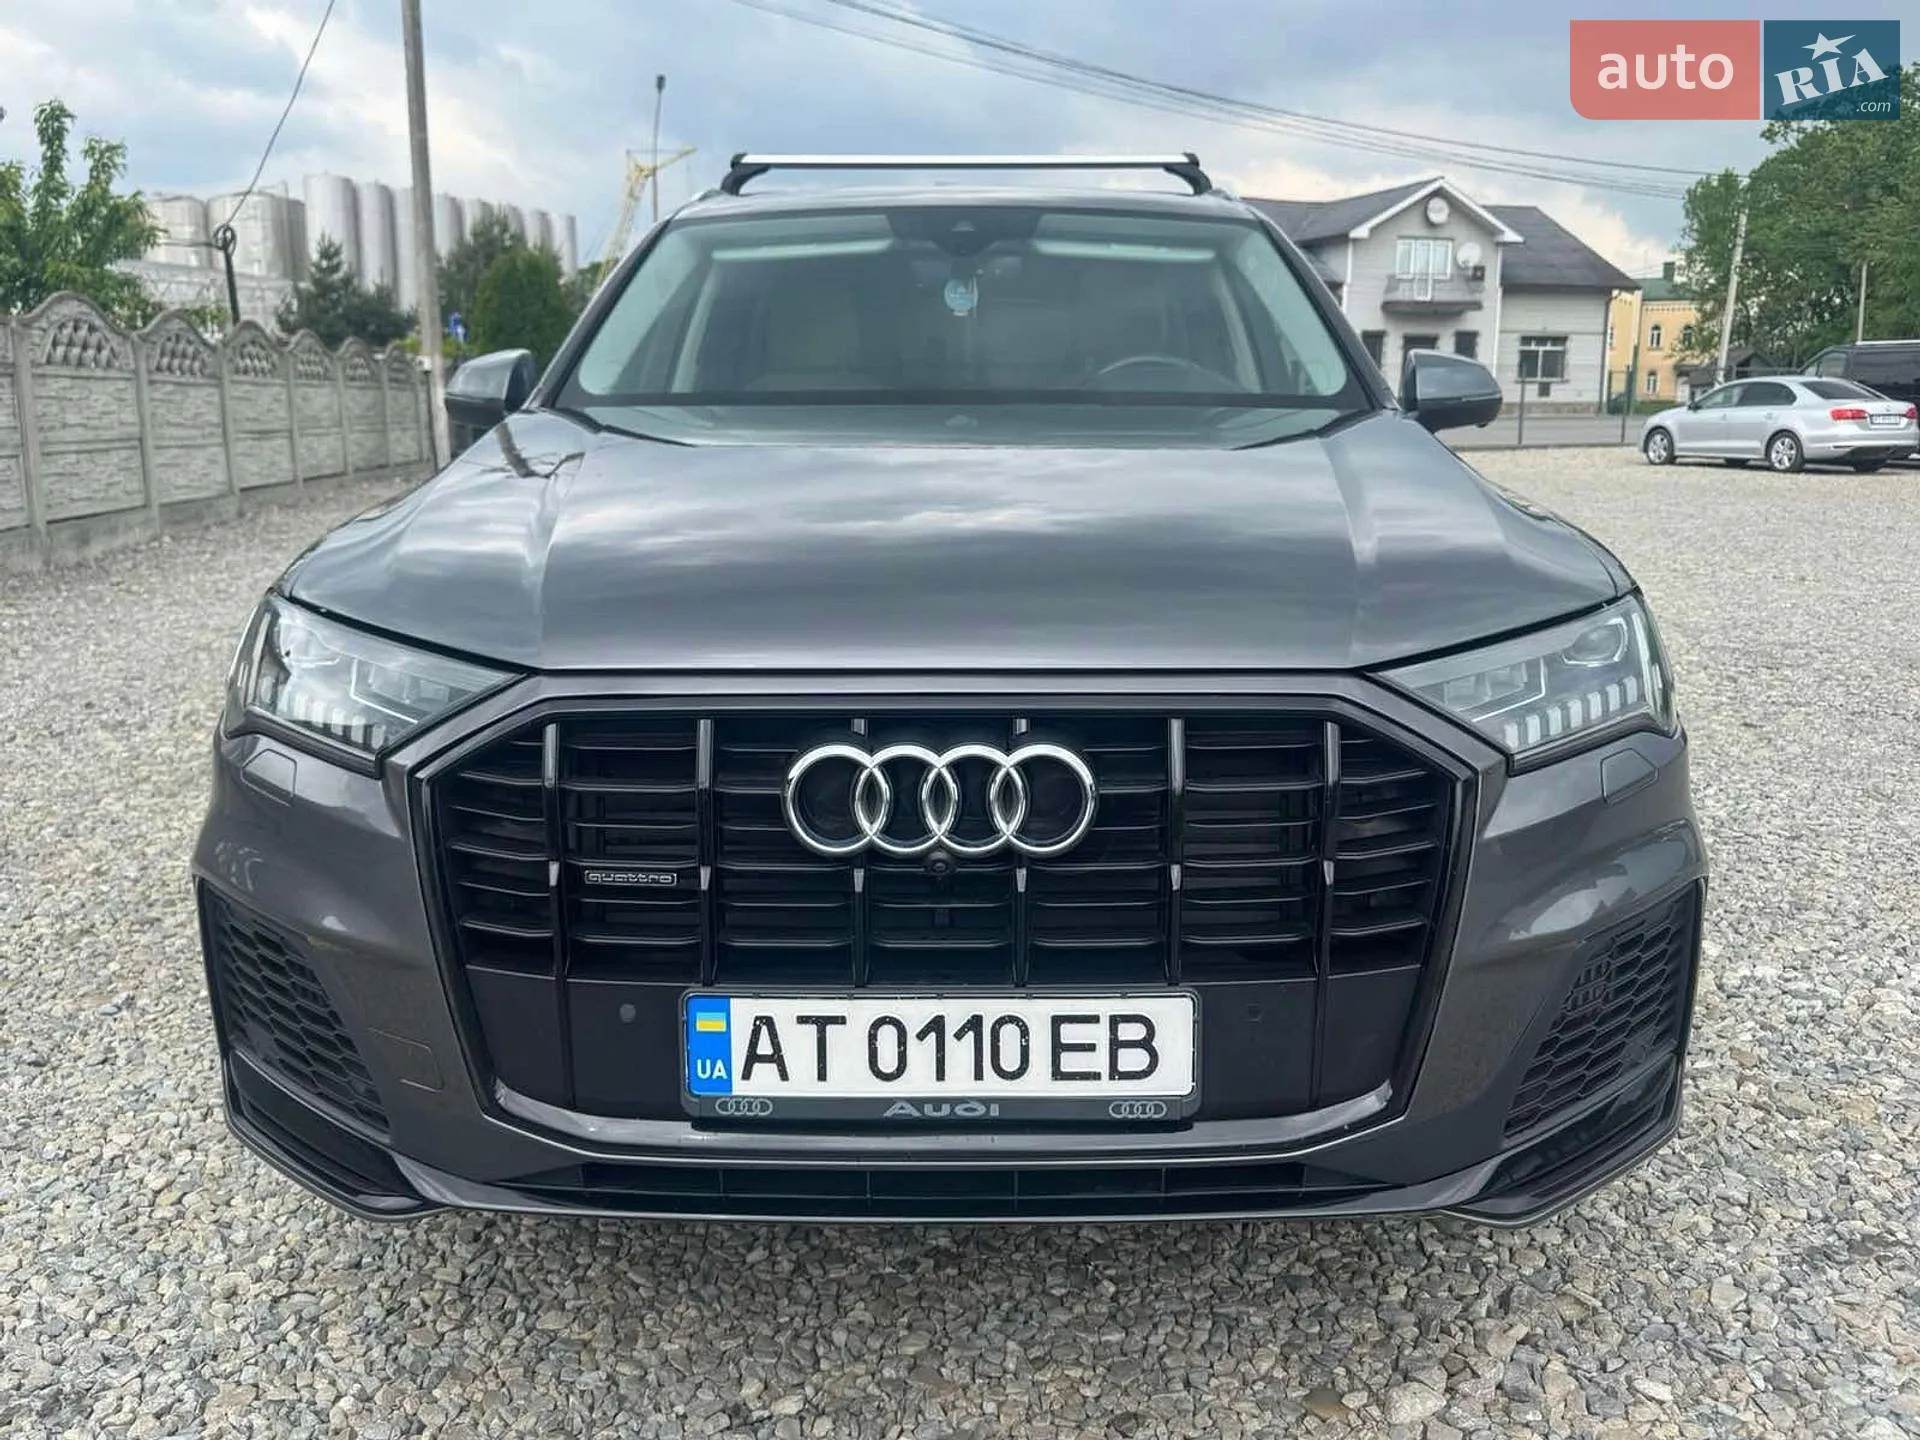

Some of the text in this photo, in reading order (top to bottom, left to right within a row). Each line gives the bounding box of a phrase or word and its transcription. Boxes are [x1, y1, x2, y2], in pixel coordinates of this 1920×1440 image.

[588, 872, 673, 884] quattro
[741, 1013, 1160, 1082] AT 0110 EB
[696, 1058, 728, 1080] UA
